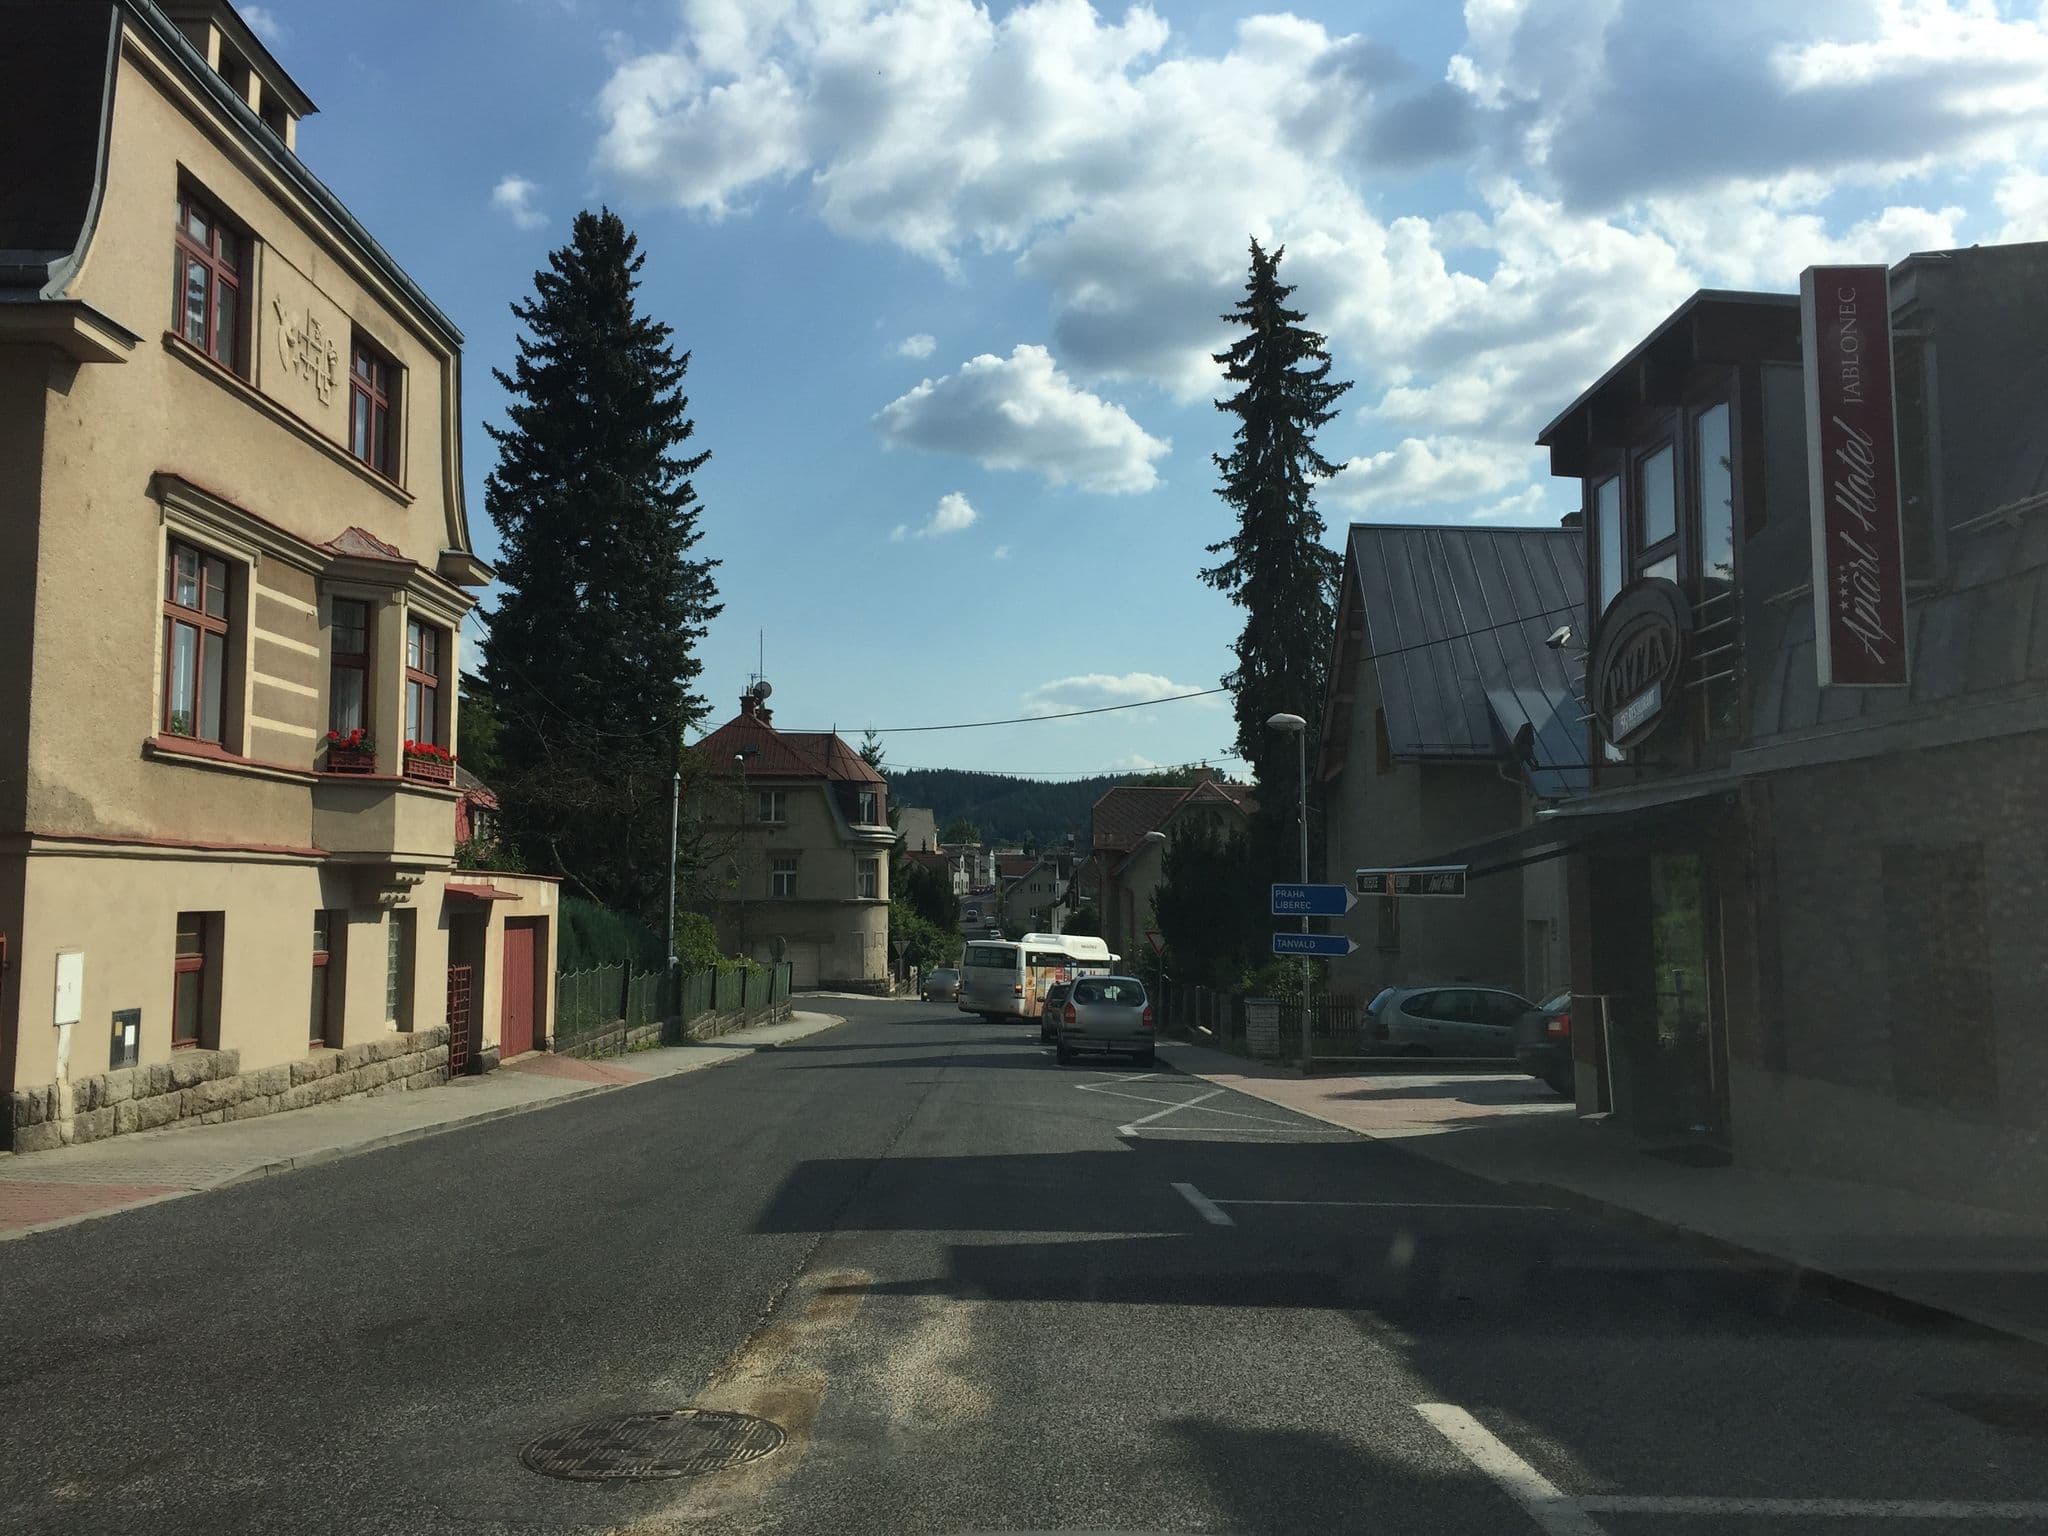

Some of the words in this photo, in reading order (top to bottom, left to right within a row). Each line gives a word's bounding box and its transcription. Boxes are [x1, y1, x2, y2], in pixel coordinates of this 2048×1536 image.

[1838, 287, 1862, 405] JABLONEC
[1833, 416, 1878, 532] Hotel
[1840, 530, 1896, 665] Apart
[1275, 889, 1305, 898] PRAHA
[1275, 901, 1312, 910] LIBEREC
[1276, 938, 1316, 949] TANVALD
